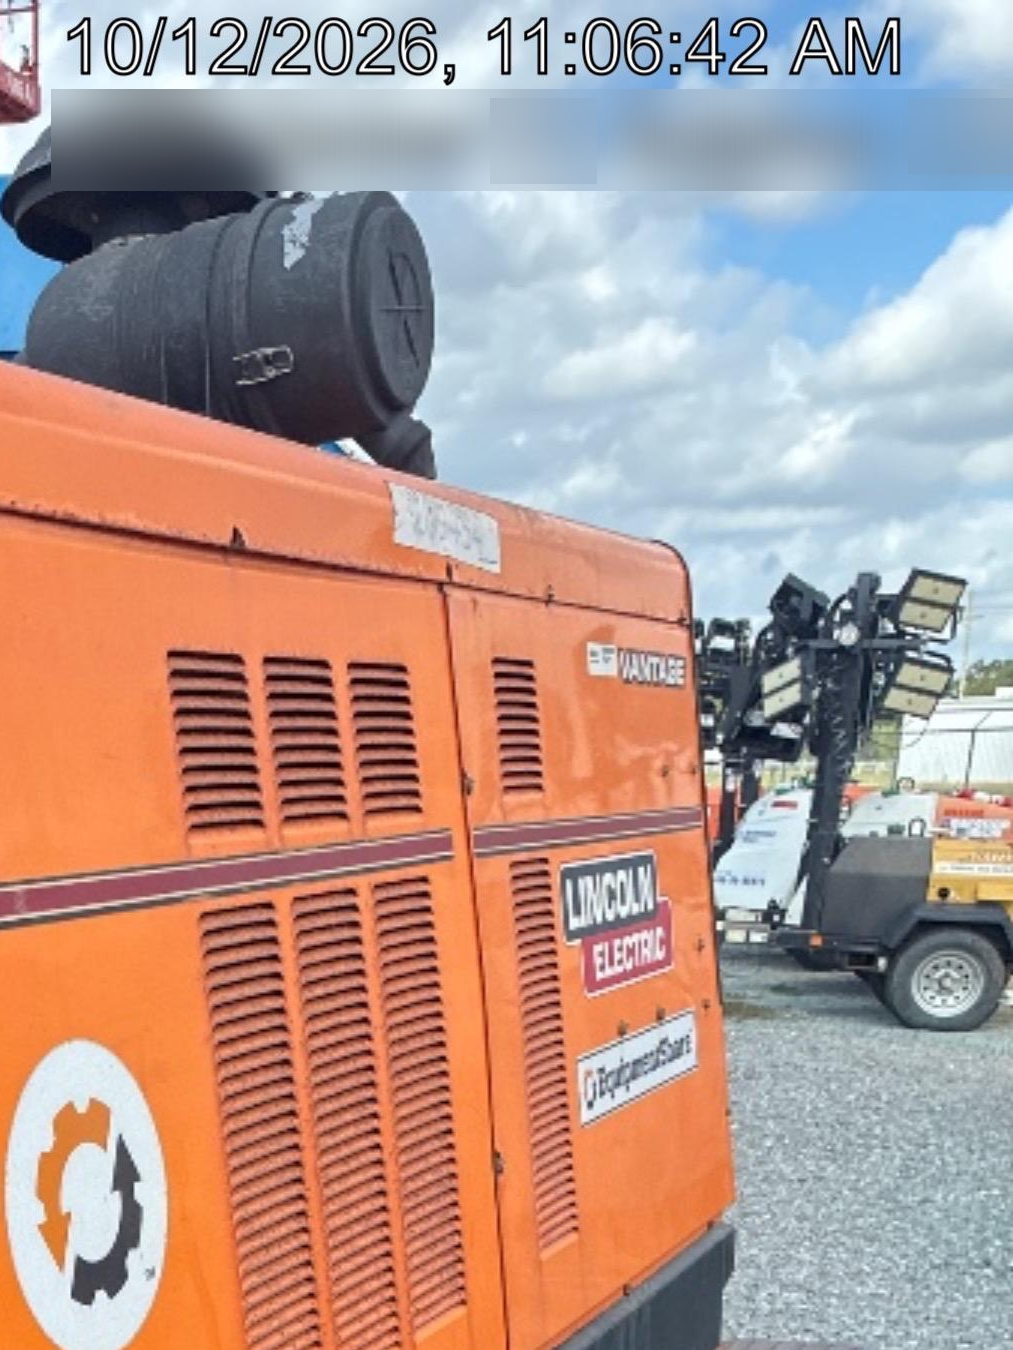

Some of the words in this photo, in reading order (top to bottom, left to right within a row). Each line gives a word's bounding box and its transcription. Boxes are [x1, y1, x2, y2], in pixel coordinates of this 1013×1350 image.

[618, 648, 686, 687] VANTAGE
[564, 863, 655, 931] LINCOLN
[592, 925, 667, 982] ELECTRIC
